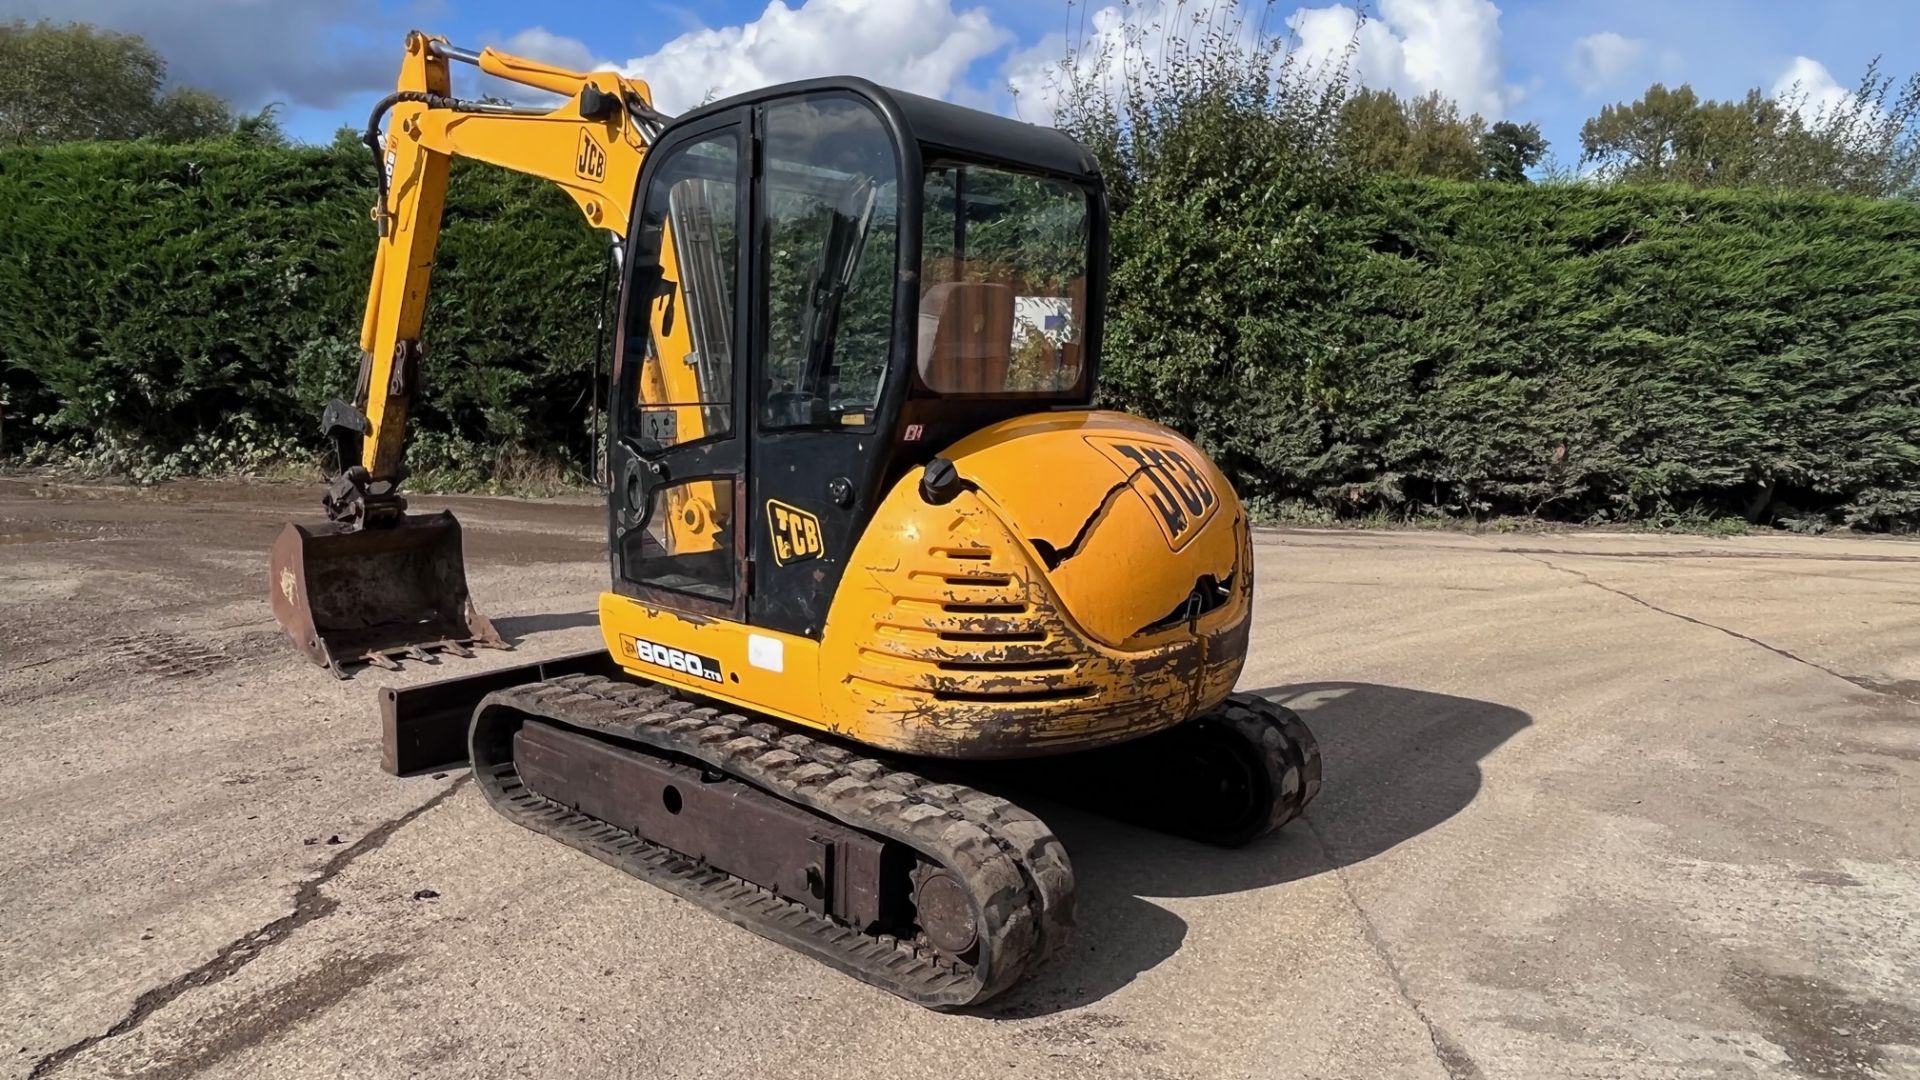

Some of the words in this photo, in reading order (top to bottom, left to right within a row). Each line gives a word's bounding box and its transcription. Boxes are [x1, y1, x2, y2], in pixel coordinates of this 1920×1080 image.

[579, 134, 604, 178] JCB
[1110, 444, 1214, 539] JCB
[775, 507, 819, 559] JCB
[636, 639, 704, 677] 8060
